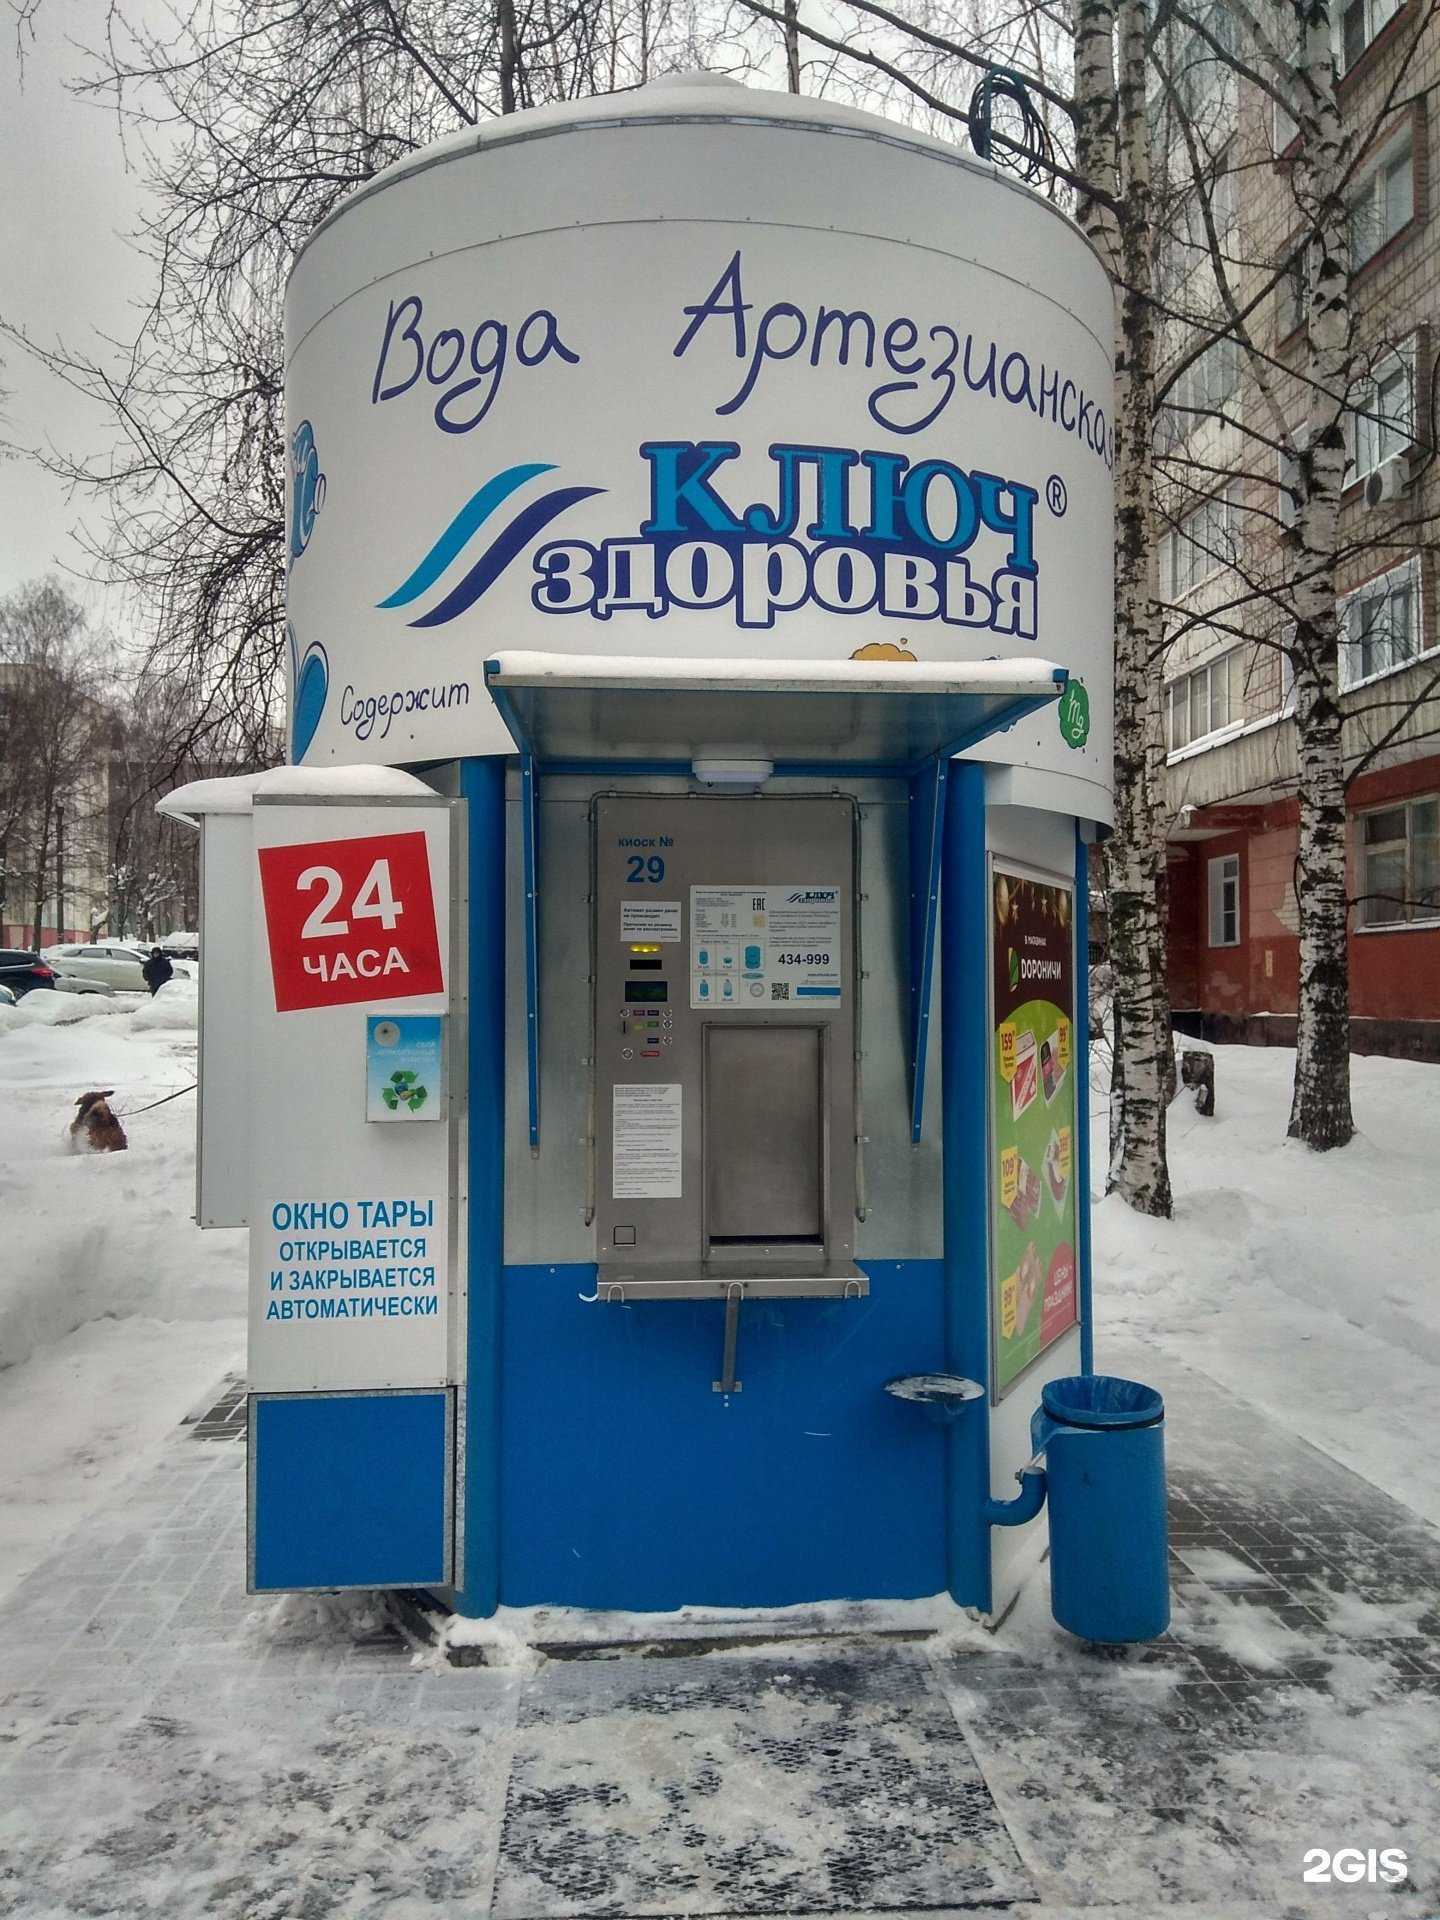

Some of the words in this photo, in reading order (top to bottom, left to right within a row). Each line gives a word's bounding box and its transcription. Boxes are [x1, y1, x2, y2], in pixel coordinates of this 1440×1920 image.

[371, 295, 580, 435] Вода
[639, 440, 1039, 573] КЛЮЧ
[340, 682, 470, 741] Содержит
[626, 855, 665, 883] 29
[296, 858, 404, 939] 24
[303, 946, 411, 982] ЧАСА
[778, 953, 830, 965] 434-999
[272, 1201, 349, 1231] ОКНО
[357, 1199, 433, 1228] ТАРЫ
[279, 1238, 426, 1262] ОТКРЫВАЕТСЯ
[270, 1271, 283, 1291] И
[289, 1266, 435, 1291] ЗАКРЫВАЕТСЯ
[266, 1295, 438, 1320] АВТОМАТИЧЕСКИ
